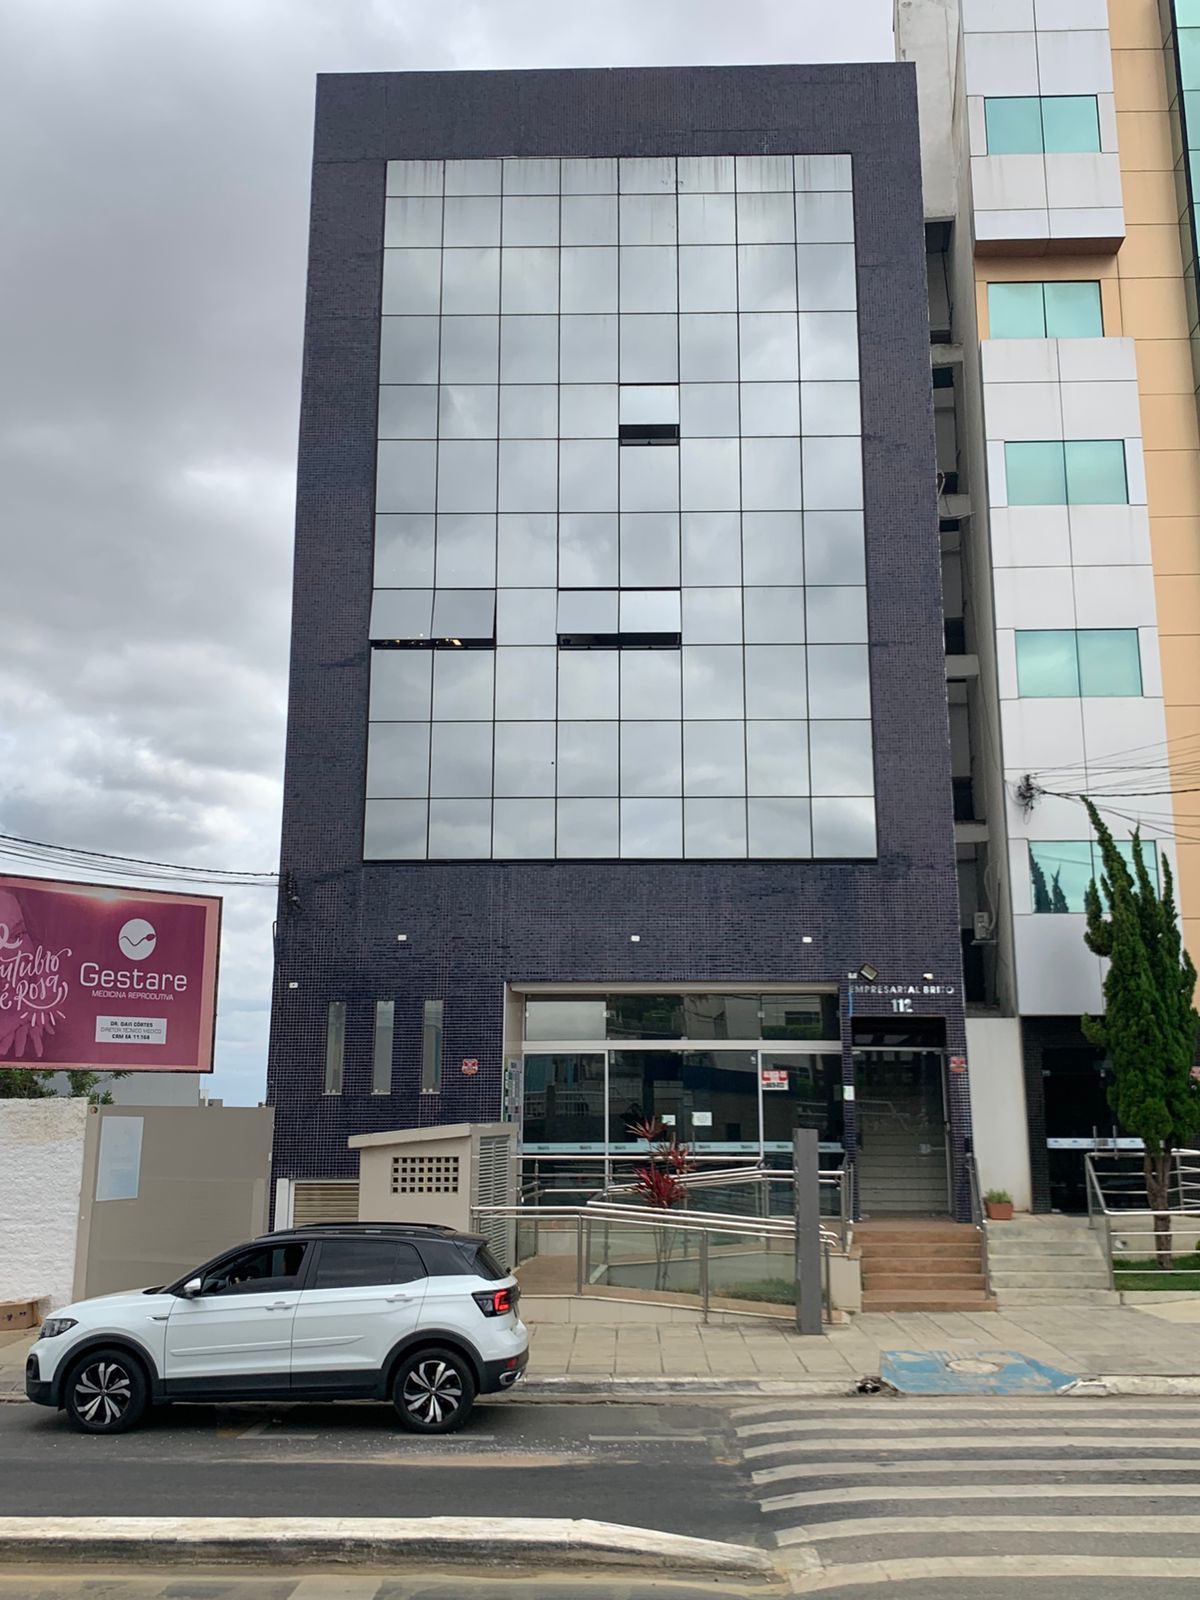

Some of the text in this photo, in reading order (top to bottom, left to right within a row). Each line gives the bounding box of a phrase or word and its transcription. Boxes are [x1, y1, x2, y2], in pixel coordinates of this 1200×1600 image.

[0, 945, 72, 988] utubro
[79, 962, 188, 992] Gestare
[14, 974, 63, 1011] Rosa
[91, 989, 174, 1001] MEDICINA REPRODUTIVA
[923, 985, 955, 994] BRITO
[890, 998, 914, 1013] 112
